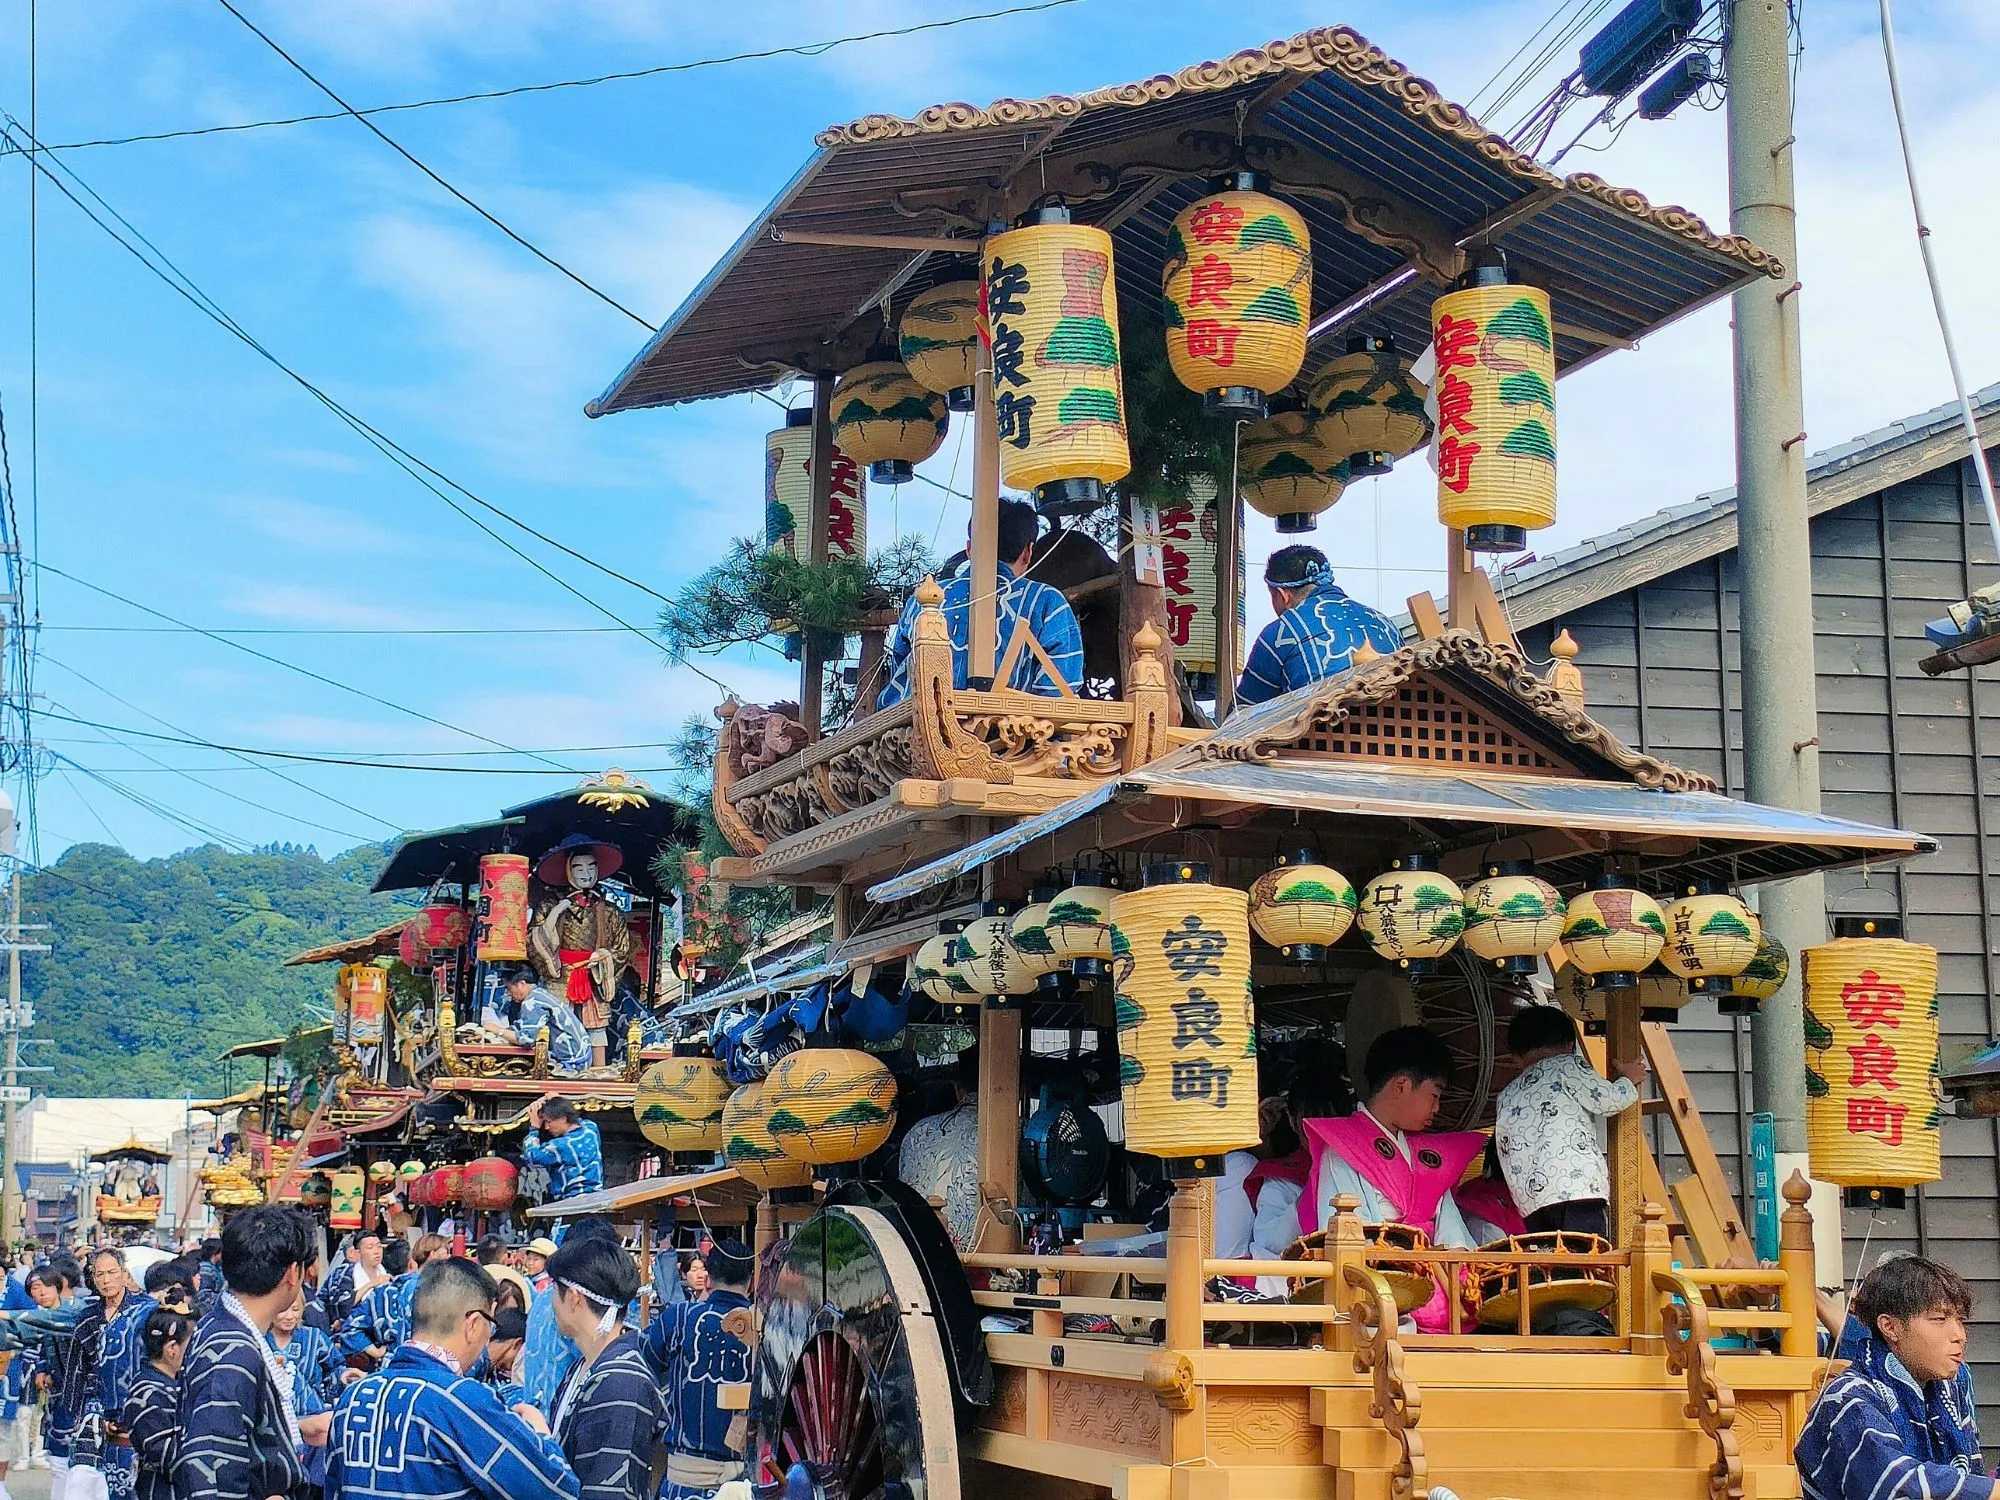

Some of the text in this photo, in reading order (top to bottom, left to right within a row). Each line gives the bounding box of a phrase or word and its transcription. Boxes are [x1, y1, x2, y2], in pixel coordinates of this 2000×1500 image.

[988, 256, 1037, 450] 安良町
[1187, 201, 1244, 367] 安良町
[1433, 314, 1482, 494] 安良町
[1161, 915, 1233, 1109] 安良町
[1840, 969, 1910, 1147] 安良町
